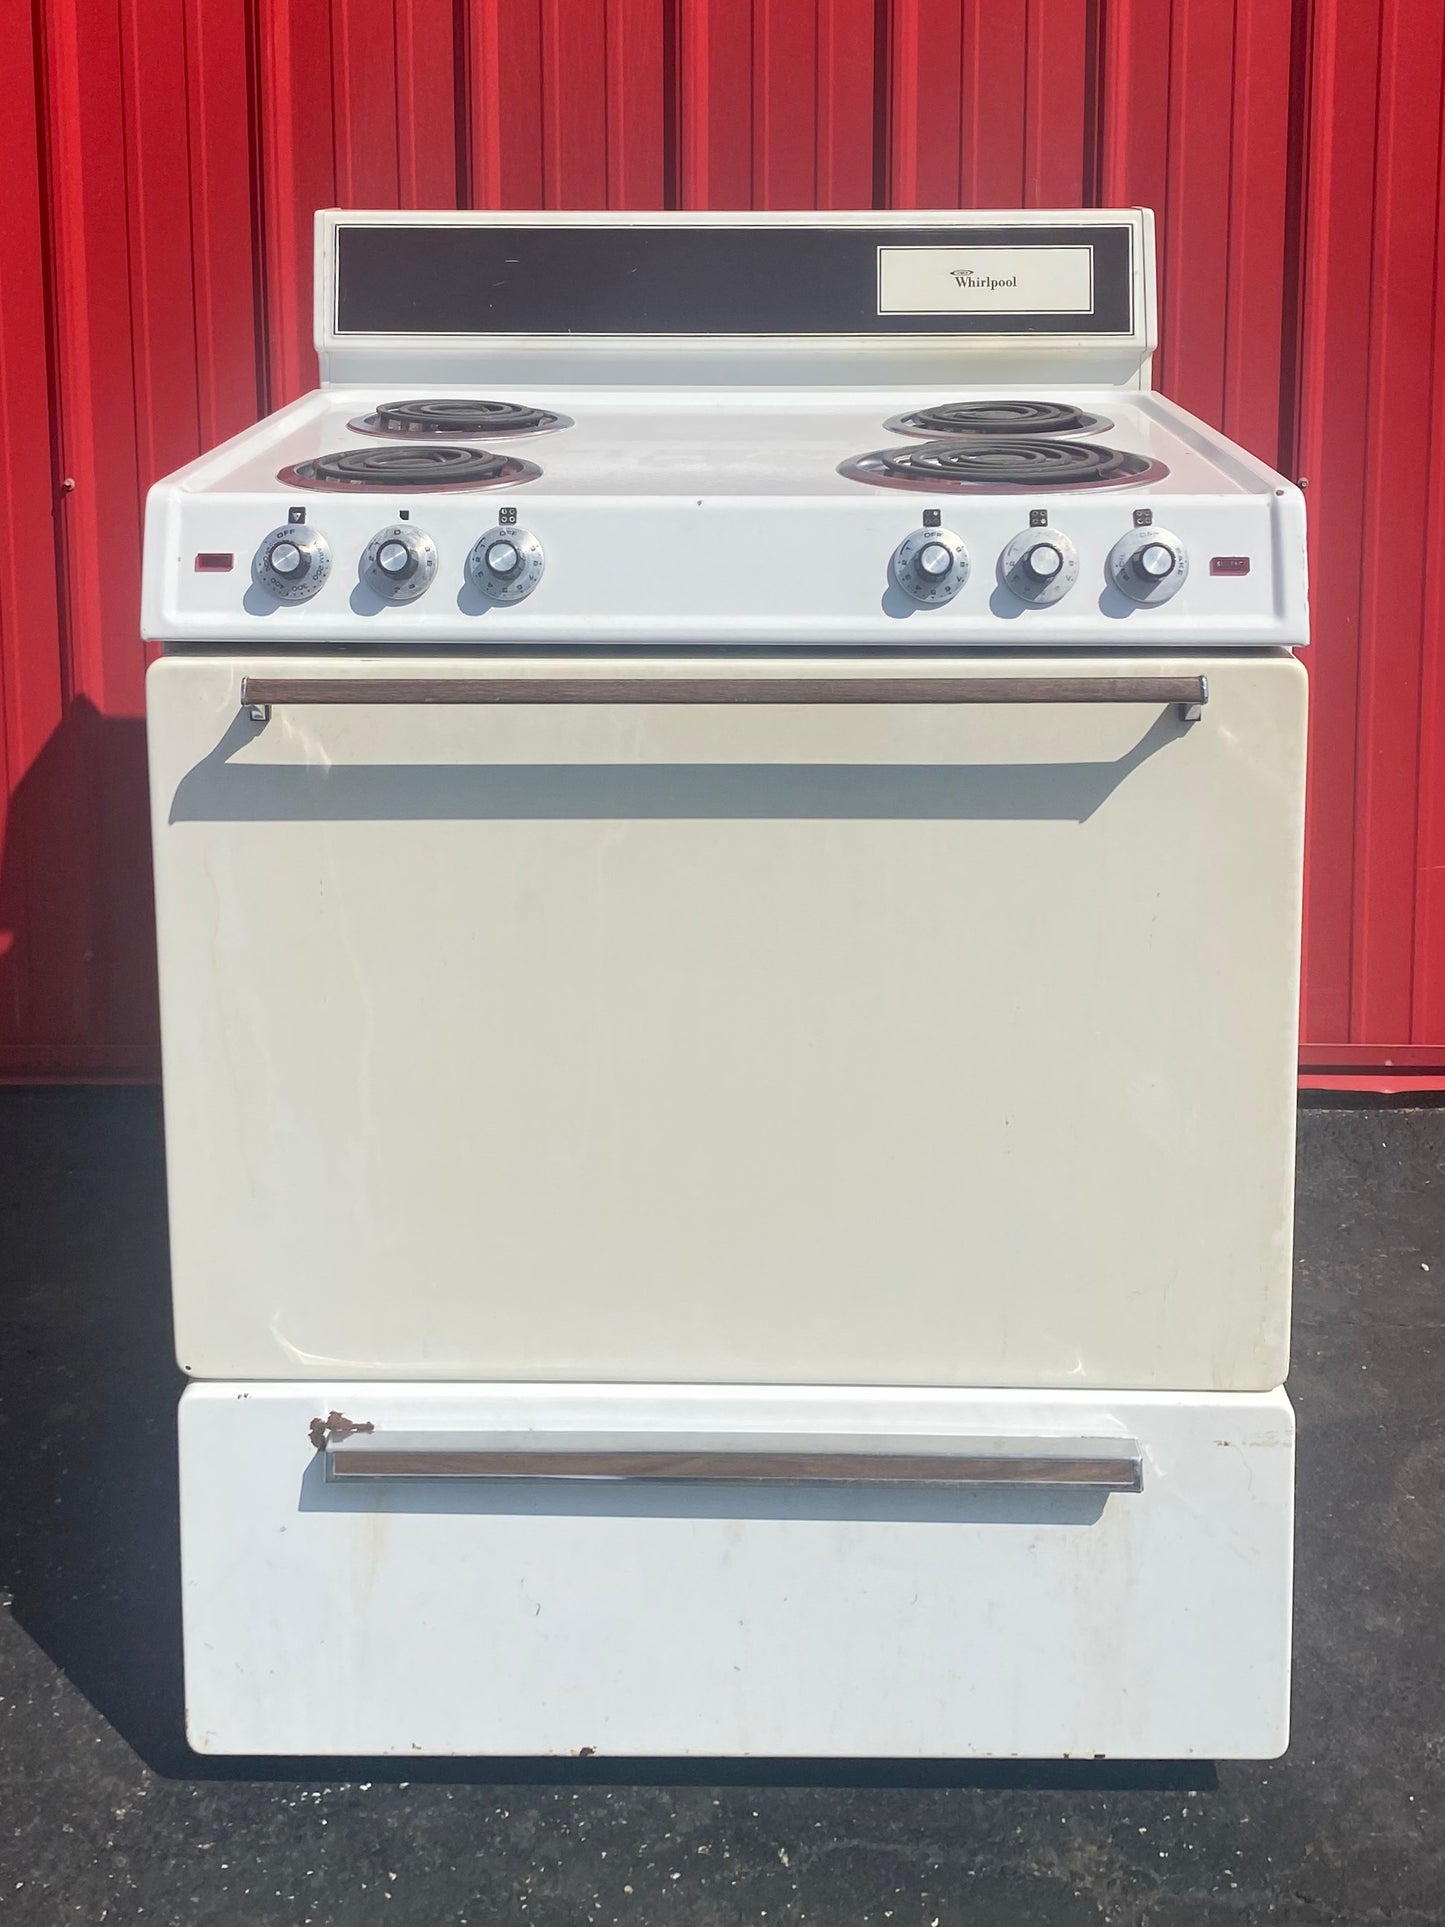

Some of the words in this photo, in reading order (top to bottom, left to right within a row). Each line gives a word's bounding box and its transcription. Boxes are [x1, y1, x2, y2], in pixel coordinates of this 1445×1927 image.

[955, 276, 1017, 290] Whirlpool
[277, 529, 295, 538] OFF
[312, 566, 324, 581] 200
